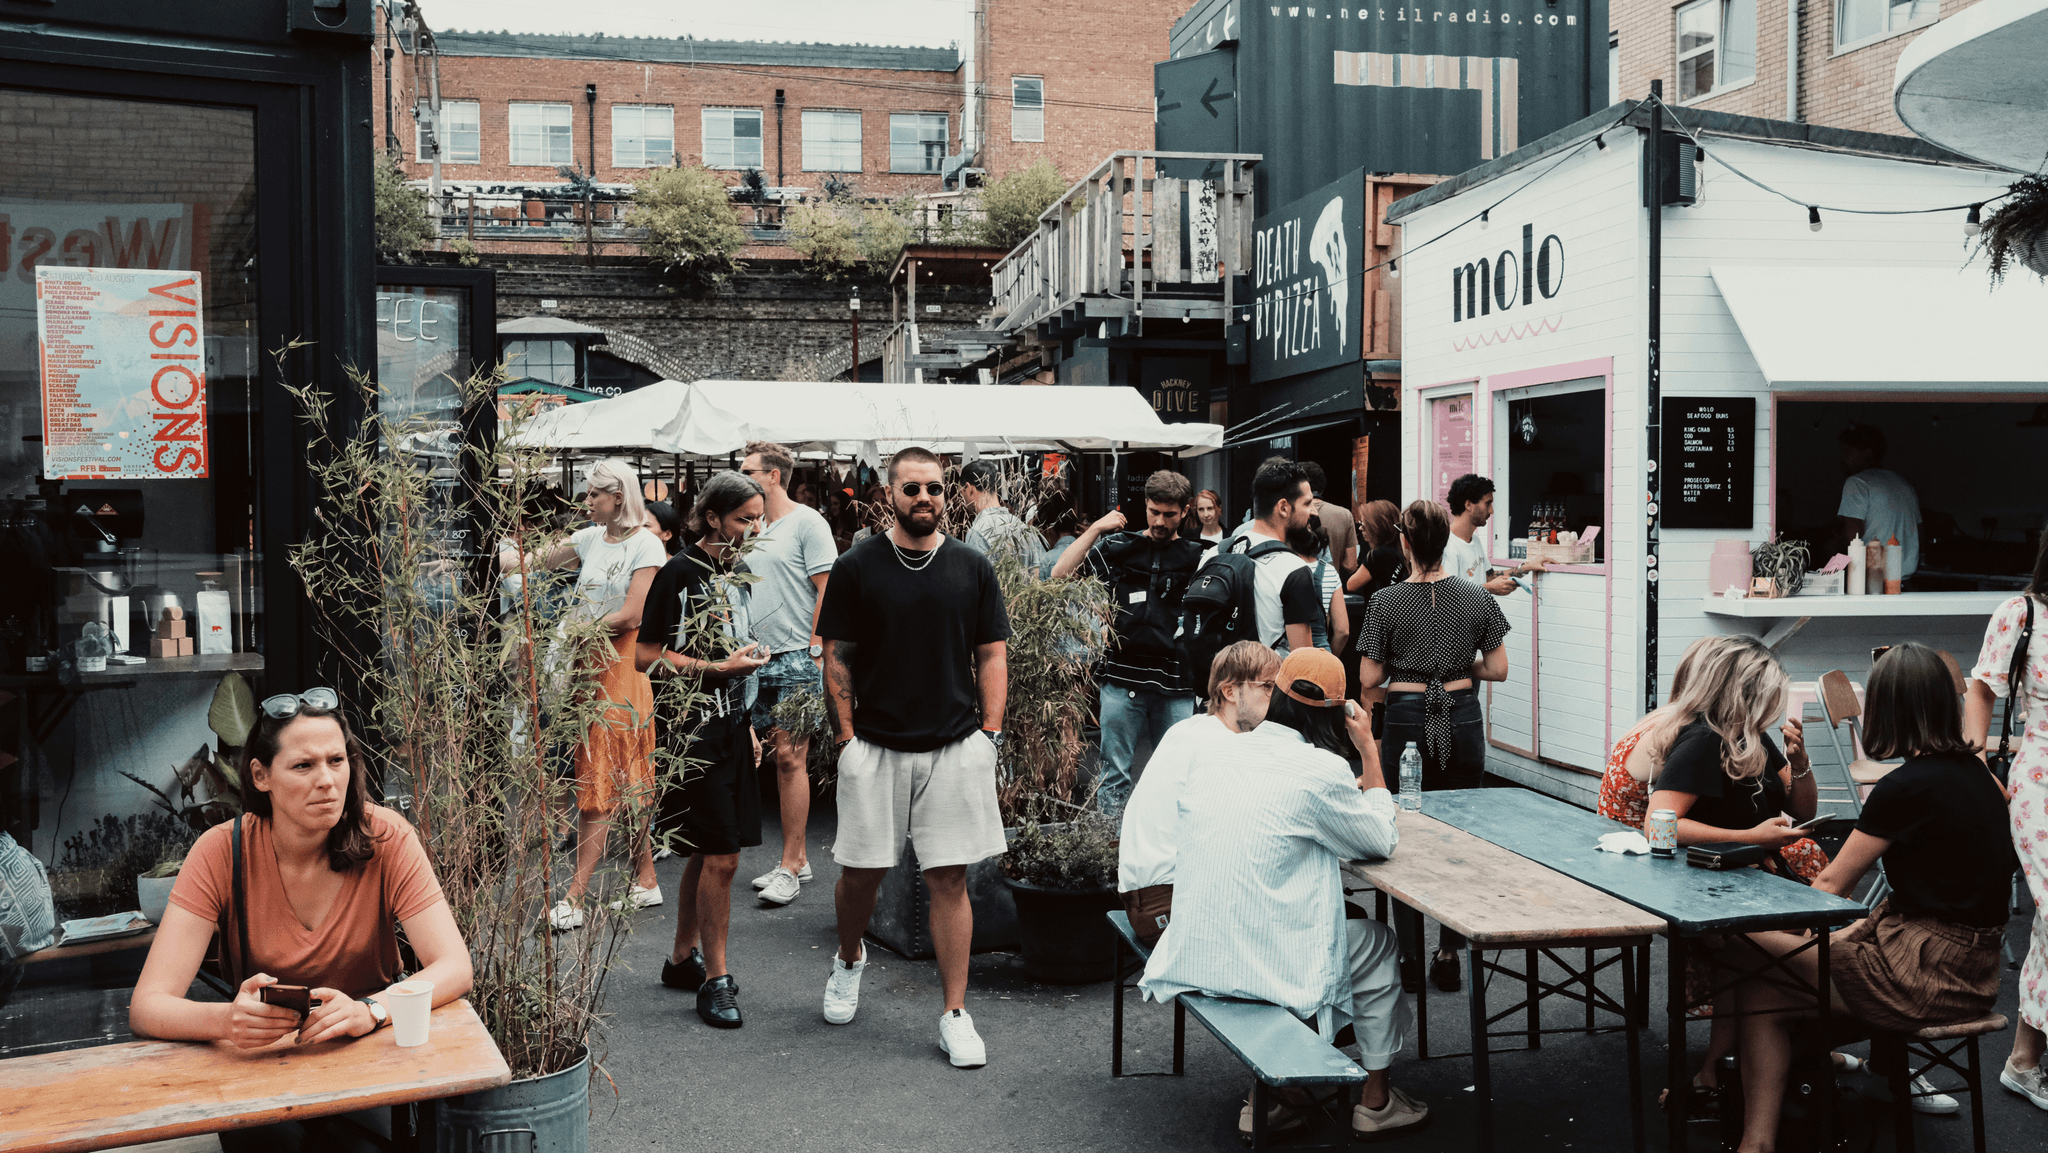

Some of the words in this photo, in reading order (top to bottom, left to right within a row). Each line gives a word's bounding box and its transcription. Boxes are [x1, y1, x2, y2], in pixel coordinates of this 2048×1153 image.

[1270, 6, 1577, 26] www.netilradio.com
[1256, 217, 1300, 288] DEATH
[1453, 223, 1564, 323] molo
[1256, 292, 1271, 340] BY
[1274, 276, 1320, 360] PIZZA
[148, 278, 202, 473] VISIONS
[1153, 390, 1198, 412] DIVE
[1160, 379, 1191, 389] HACKNEY
